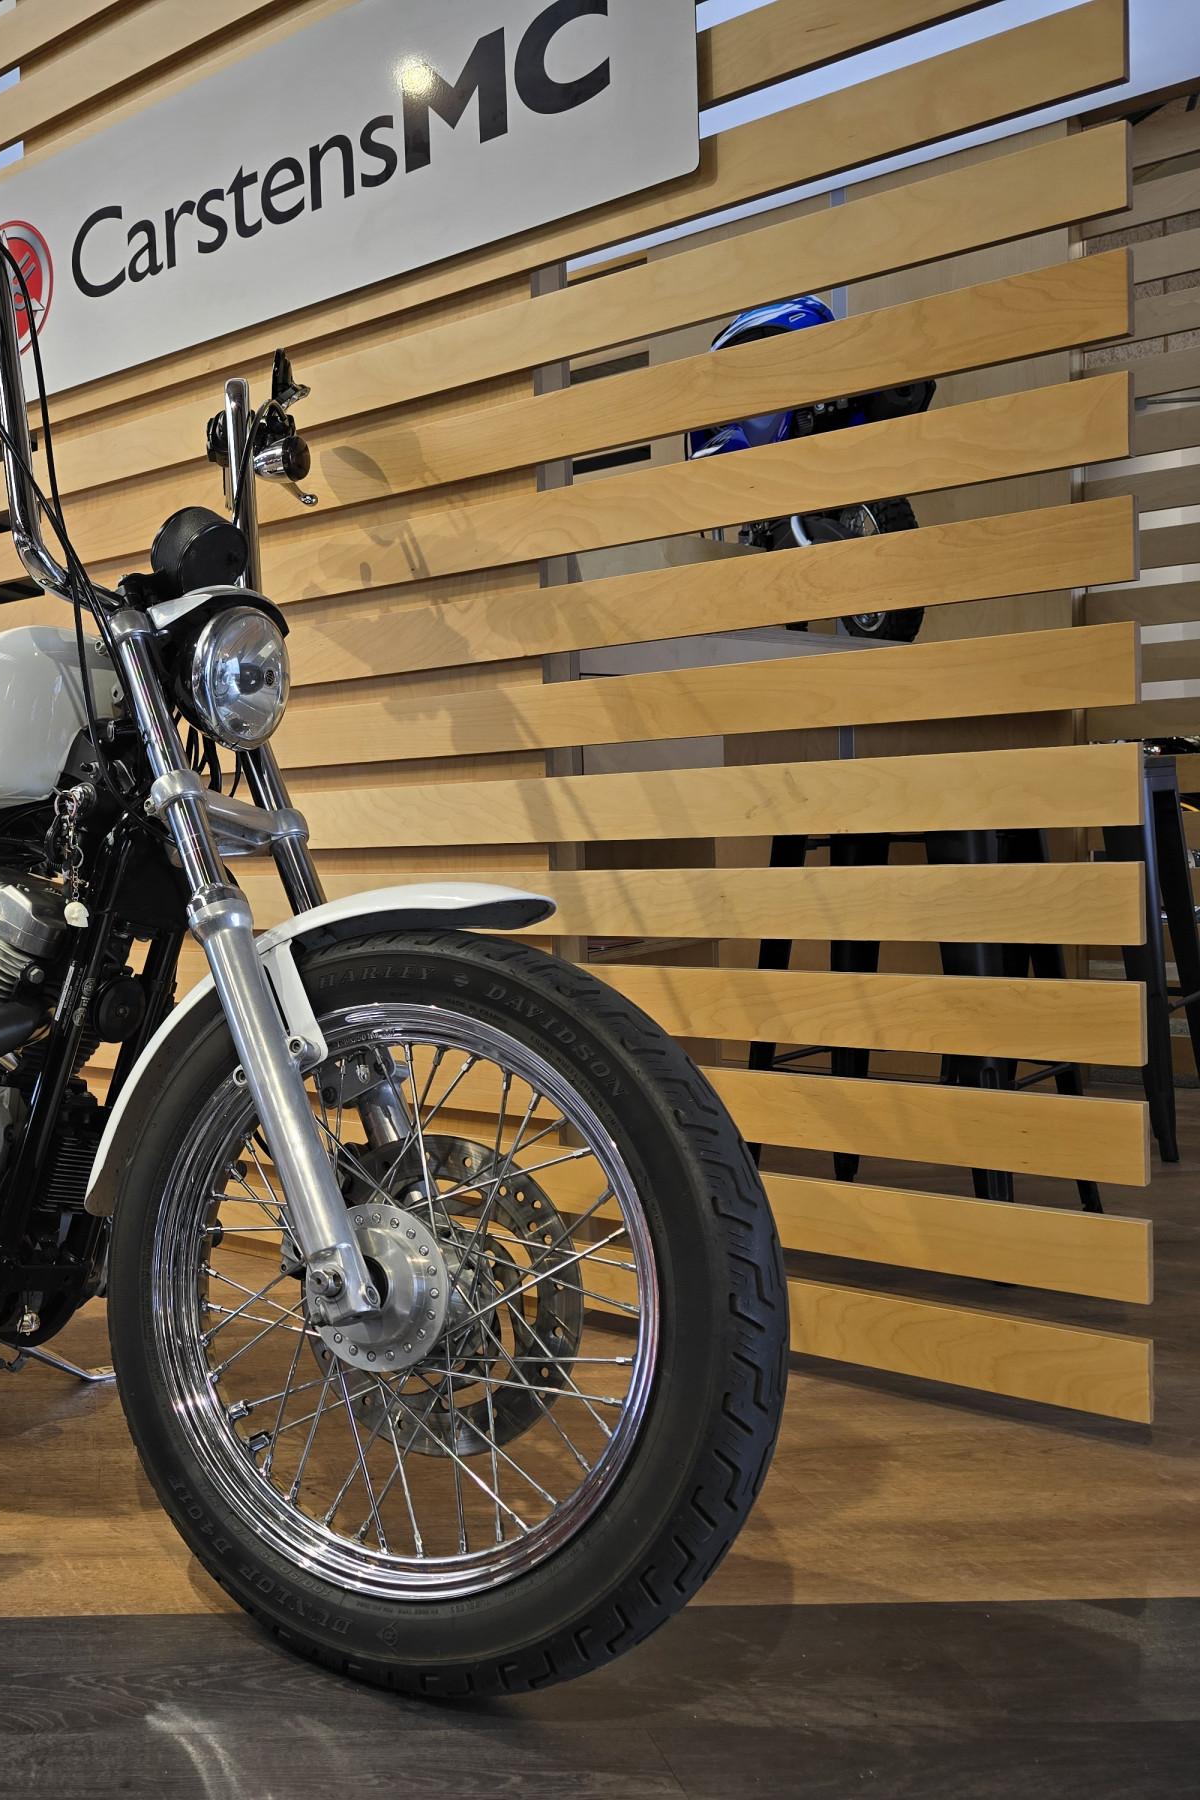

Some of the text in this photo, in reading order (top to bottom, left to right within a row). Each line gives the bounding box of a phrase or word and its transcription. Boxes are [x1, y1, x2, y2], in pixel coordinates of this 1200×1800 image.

[319, 964, 436, 989] HARLEY
[482, 980, 626, 1098] DAVIDSON
[238, 1563, 354, 1636] DUNLOP
